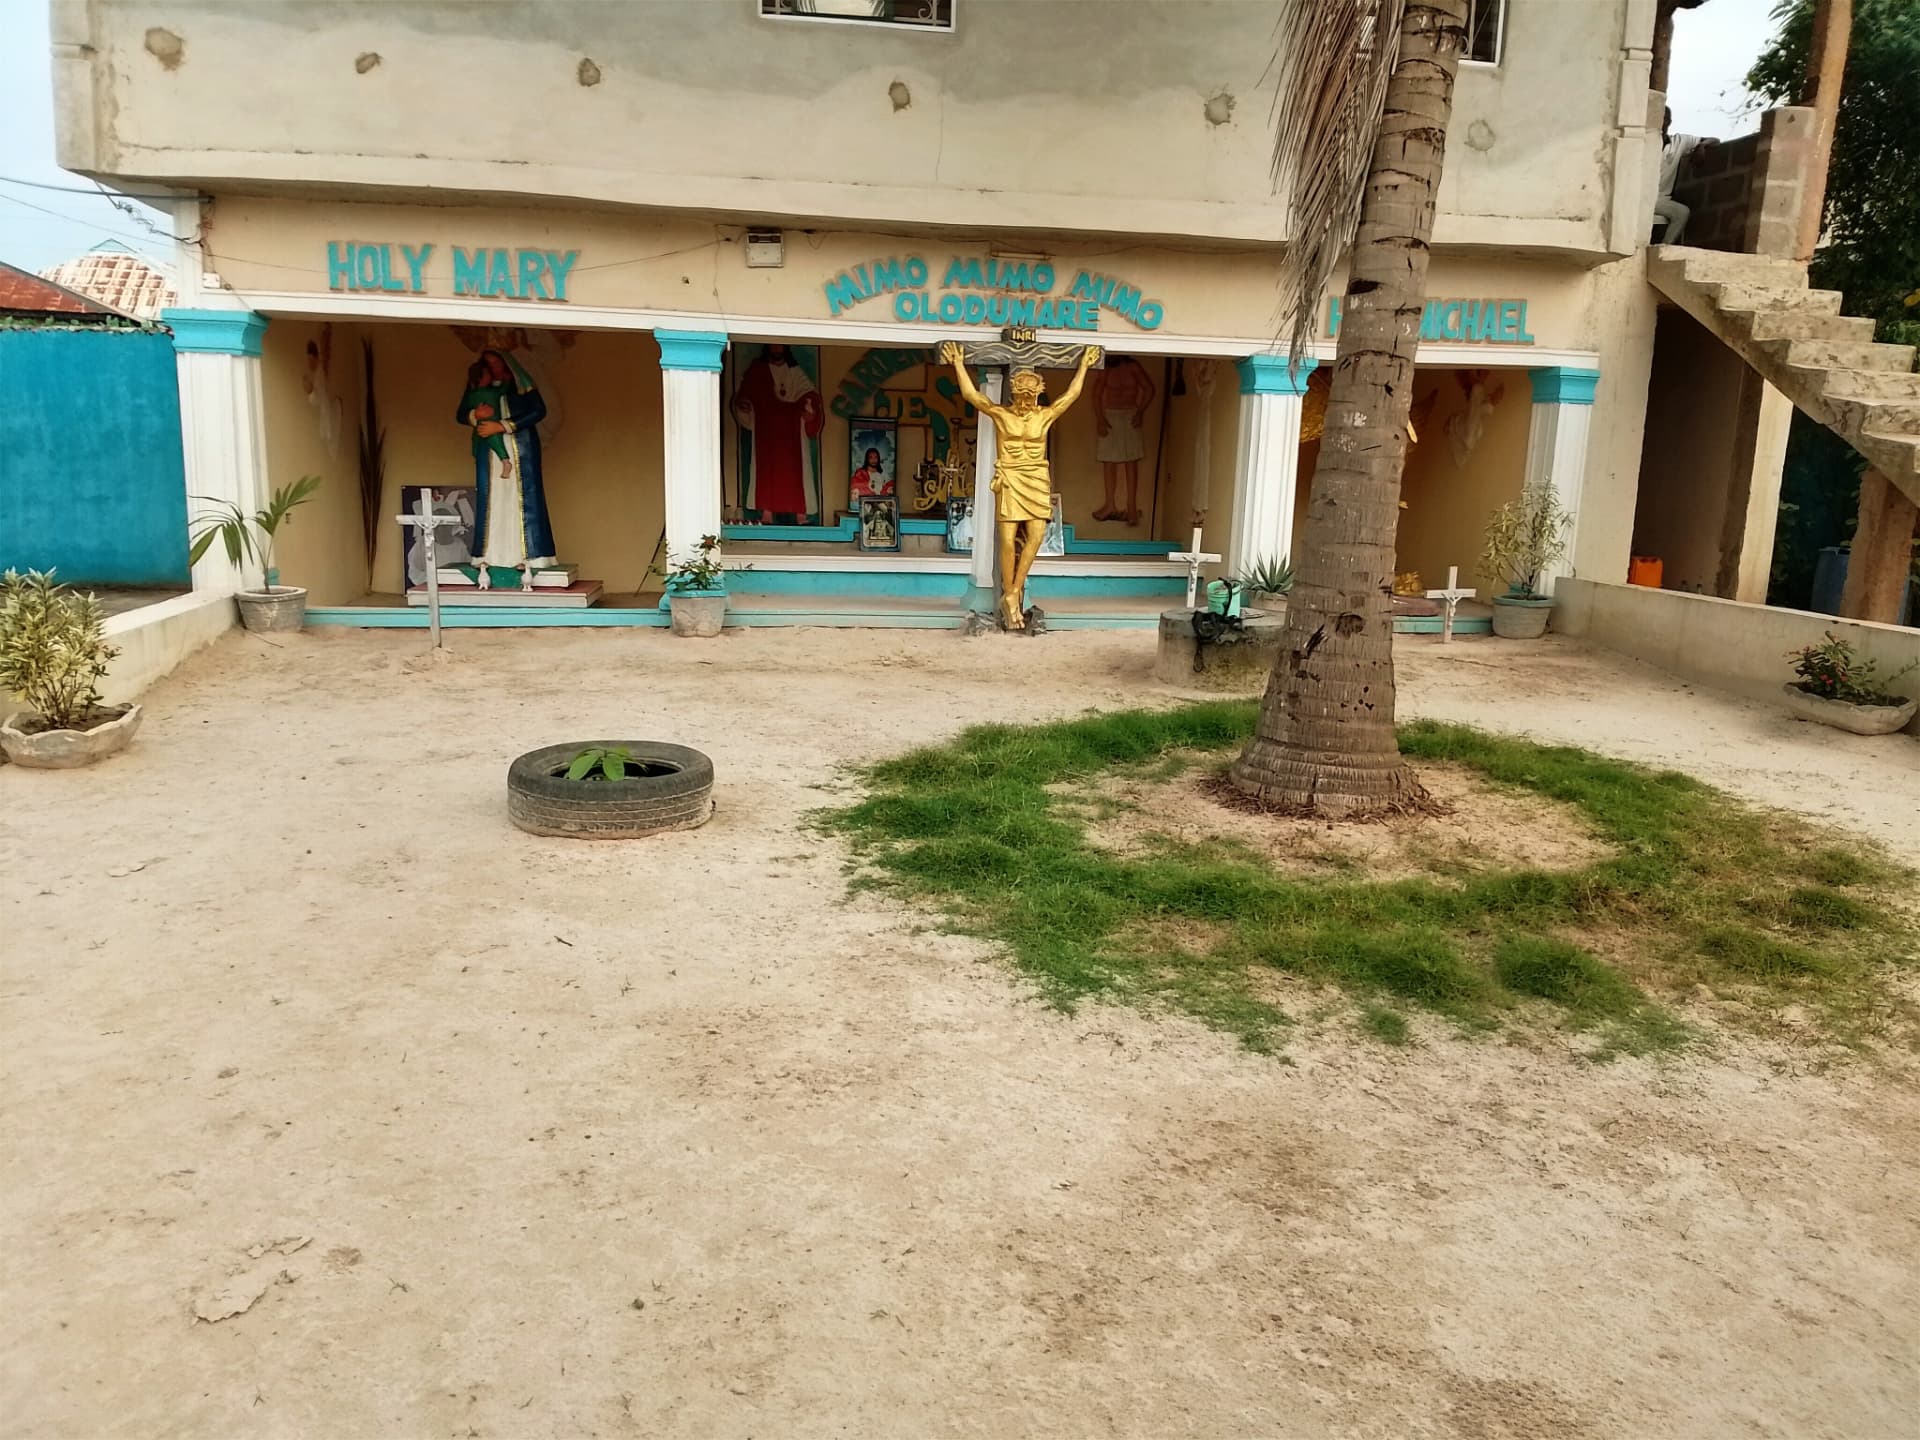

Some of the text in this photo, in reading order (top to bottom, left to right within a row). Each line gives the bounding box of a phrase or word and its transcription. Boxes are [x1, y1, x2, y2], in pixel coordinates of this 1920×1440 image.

[327, 241, 579, 302] HOLY MARY
[825, 255, 1164, 331] MIMO MIMO MIMO
[895, 293, 1099, 330] OLODUMARE
[1012, 329, 1035, 342] INRI
